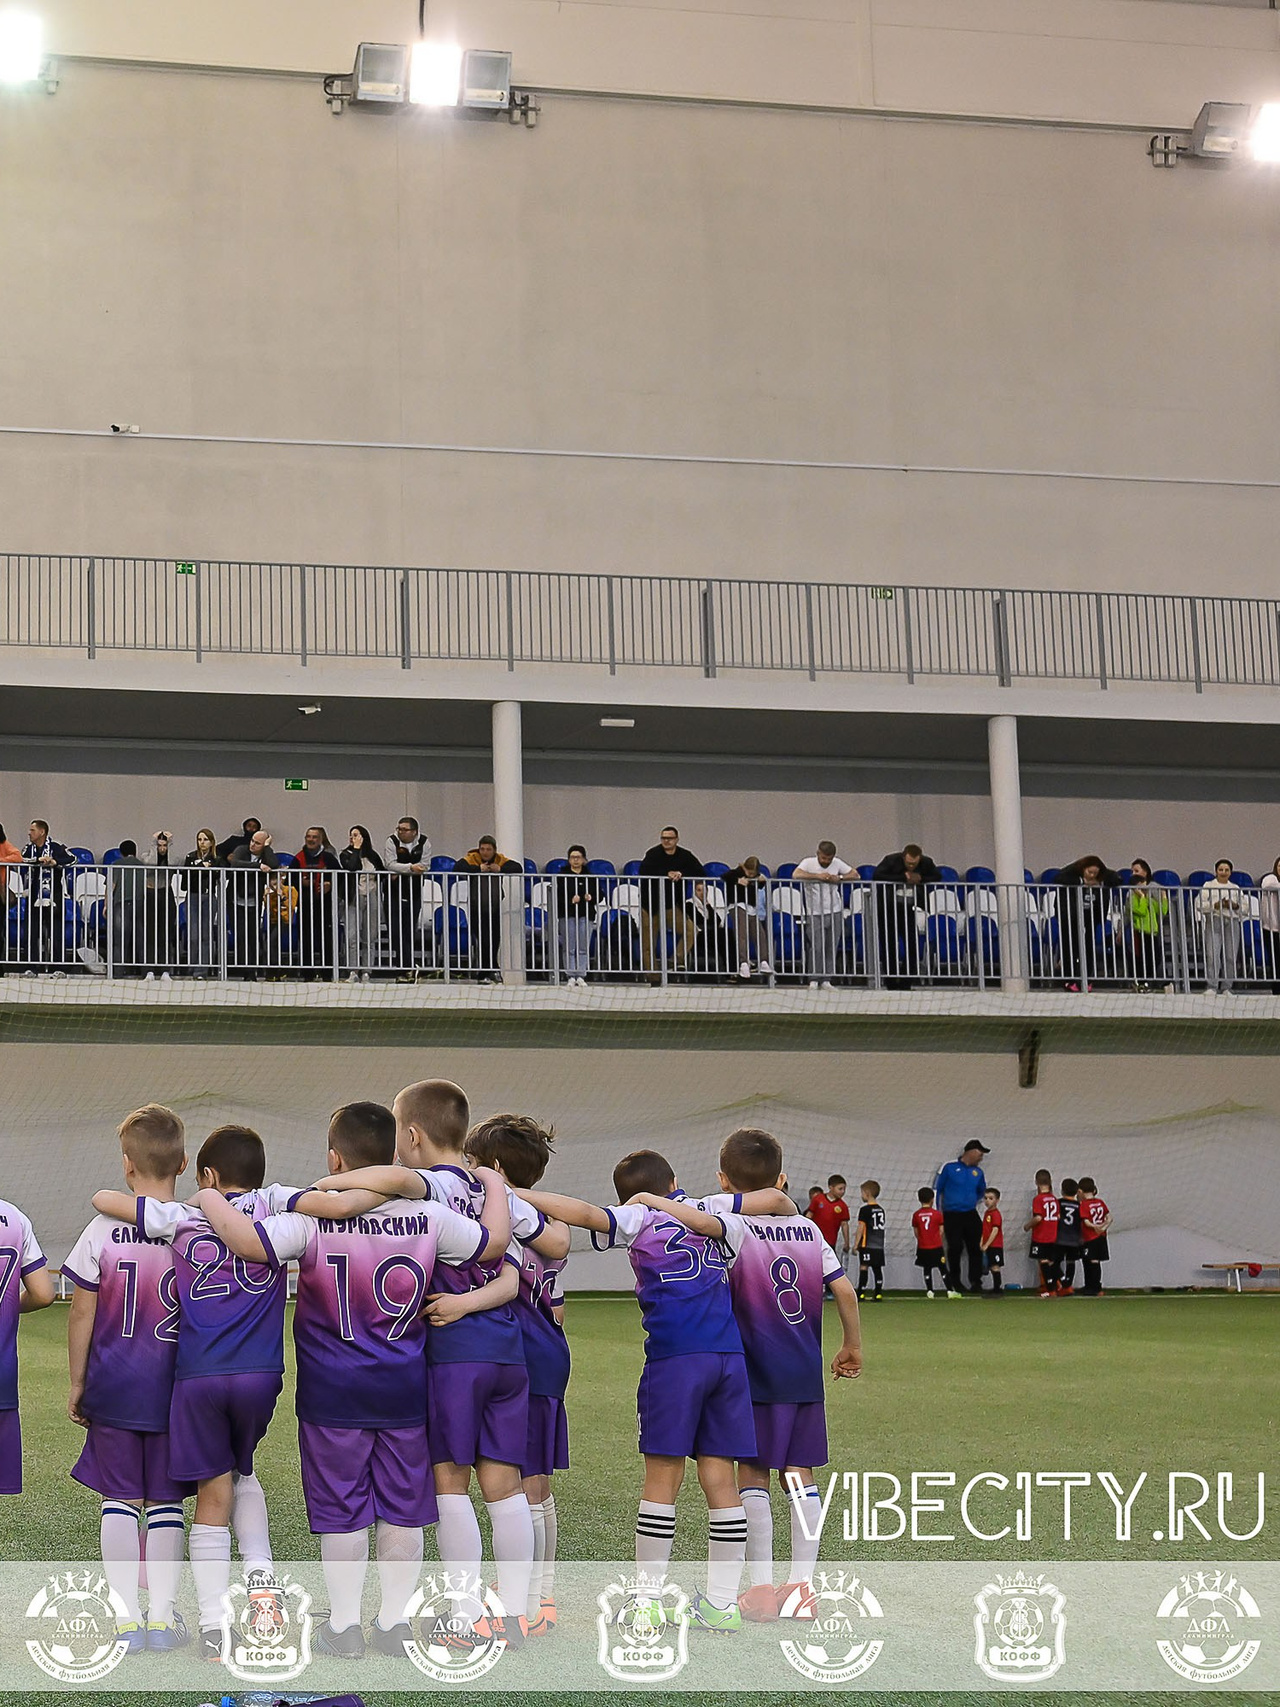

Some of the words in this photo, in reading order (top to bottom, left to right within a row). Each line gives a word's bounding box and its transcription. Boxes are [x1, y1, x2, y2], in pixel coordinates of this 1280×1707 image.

[872, 1212, 885, 1230] 13
[1043, 1202, 1057, 1221] 12
[1064, 1207, 1075, 1225] 3
[1090, 1207, 1104, 1224] 22
[317, 1211, 429, 1236] МУРАВСКИЙ
[921, 1216, 931, 1230] 7
[326, 1253, 428, 1341] 19
[769, 1255, 807, 1325] 8
[116, 1260, 181, 1342] 12
